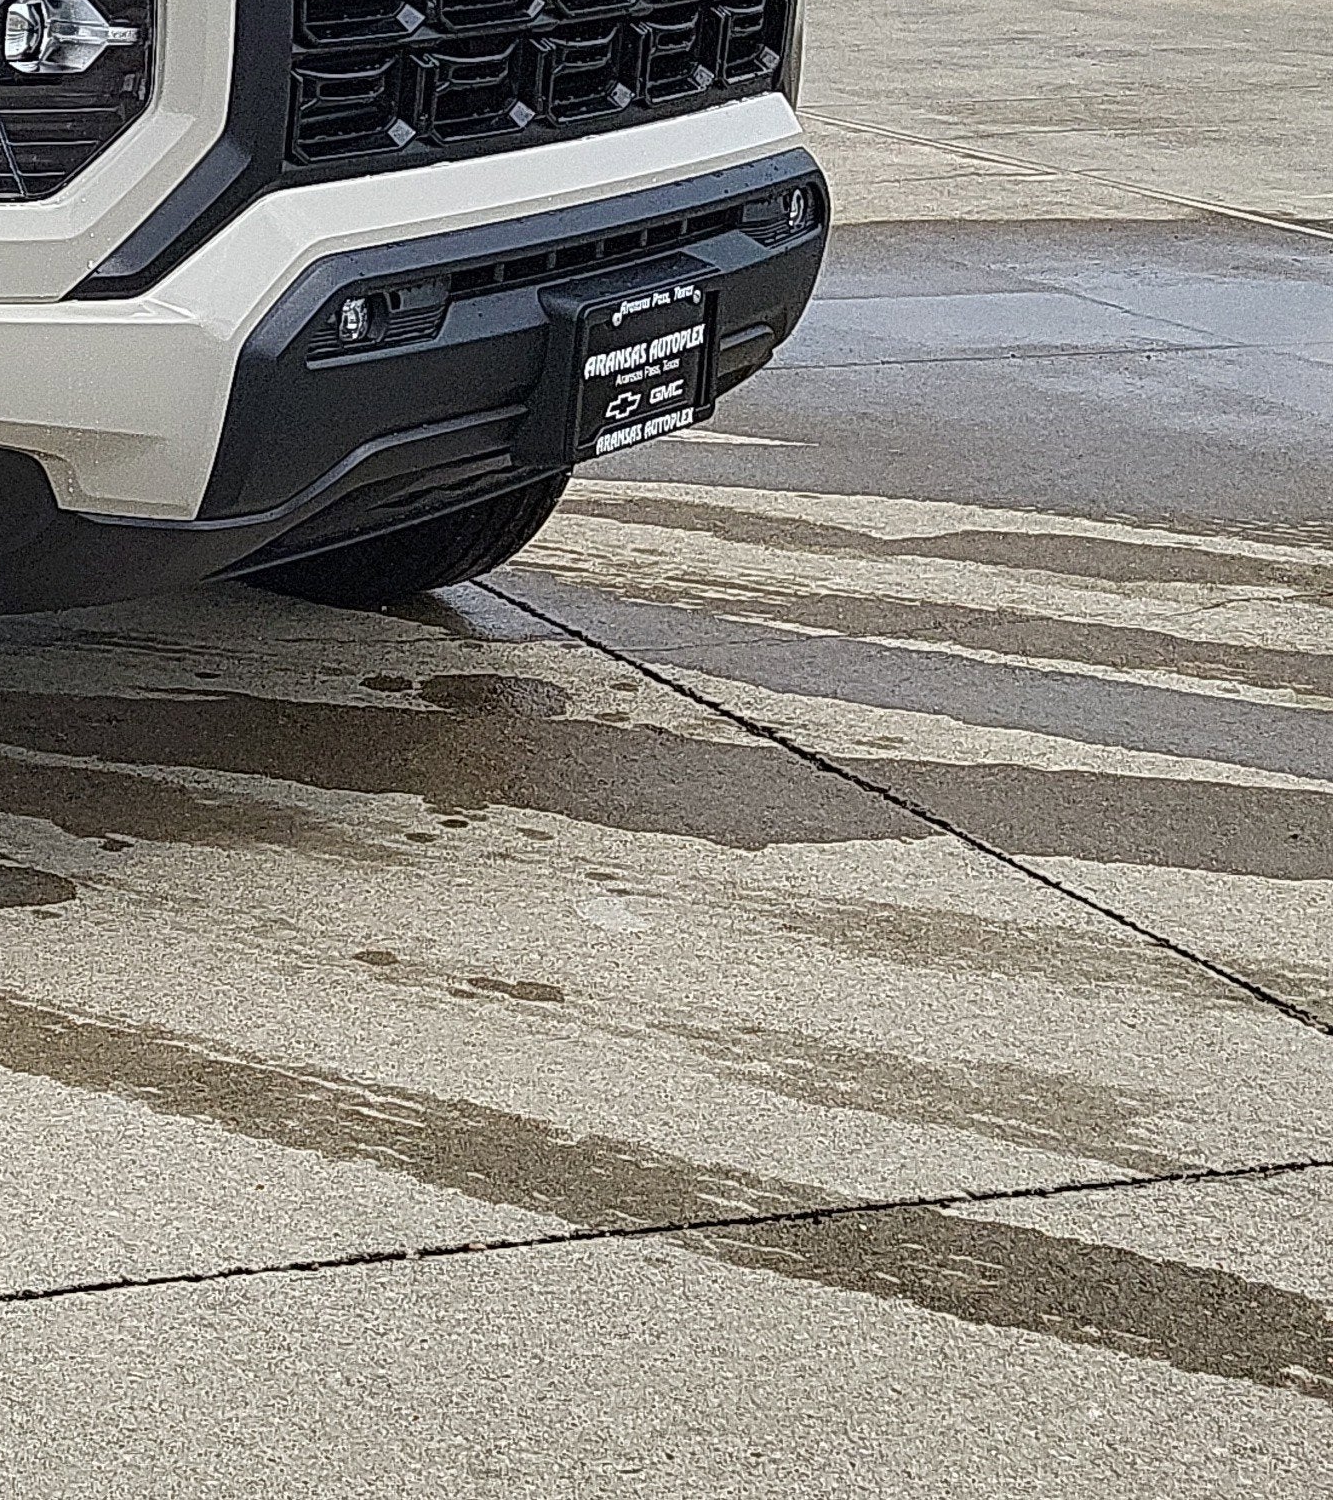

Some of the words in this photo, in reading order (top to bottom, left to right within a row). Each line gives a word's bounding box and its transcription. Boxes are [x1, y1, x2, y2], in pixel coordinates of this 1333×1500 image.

[584, 342, 648, 380] ARANSAS
[649, 323, 706, 362] AUTOPLEX
[649, 379, 684, 404] GMC
[595, 423, 642, 455] ARANSAS
[644, 406, 695, 440] AUTOPLEX
